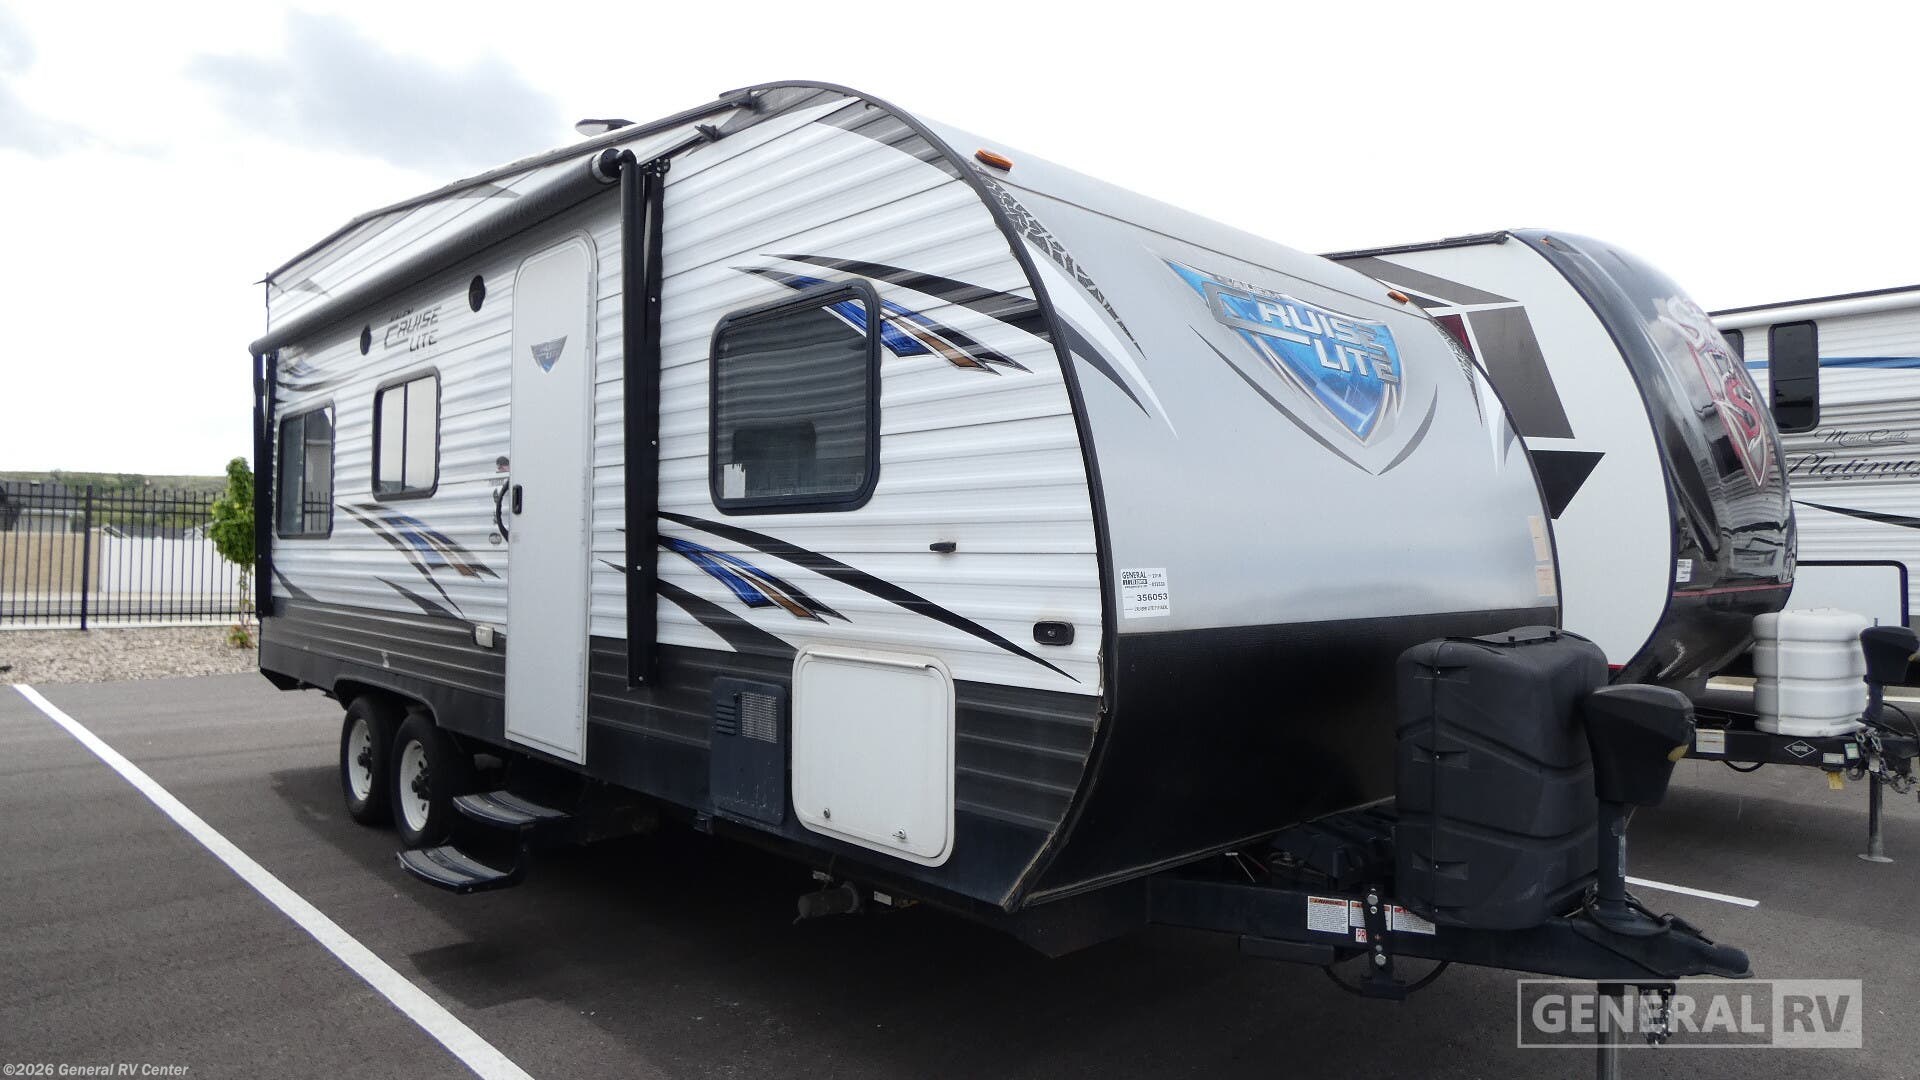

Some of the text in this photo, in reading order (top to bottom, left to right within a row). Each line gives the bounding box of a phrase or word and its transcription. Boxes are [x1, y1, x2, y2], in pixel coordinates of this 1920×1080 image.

[384, 305, 442, 350] CRUISE
[1201, 280, 1386, 352] CRUISE
[409, 328, 439, 352] LITE
[1313, 337, 1399, 383] LITE
[1122, 571, 1147, 579] GENERAL
[1136, 592, 1168, 602] 356053
[1357, 929, 1367, 942] PR
